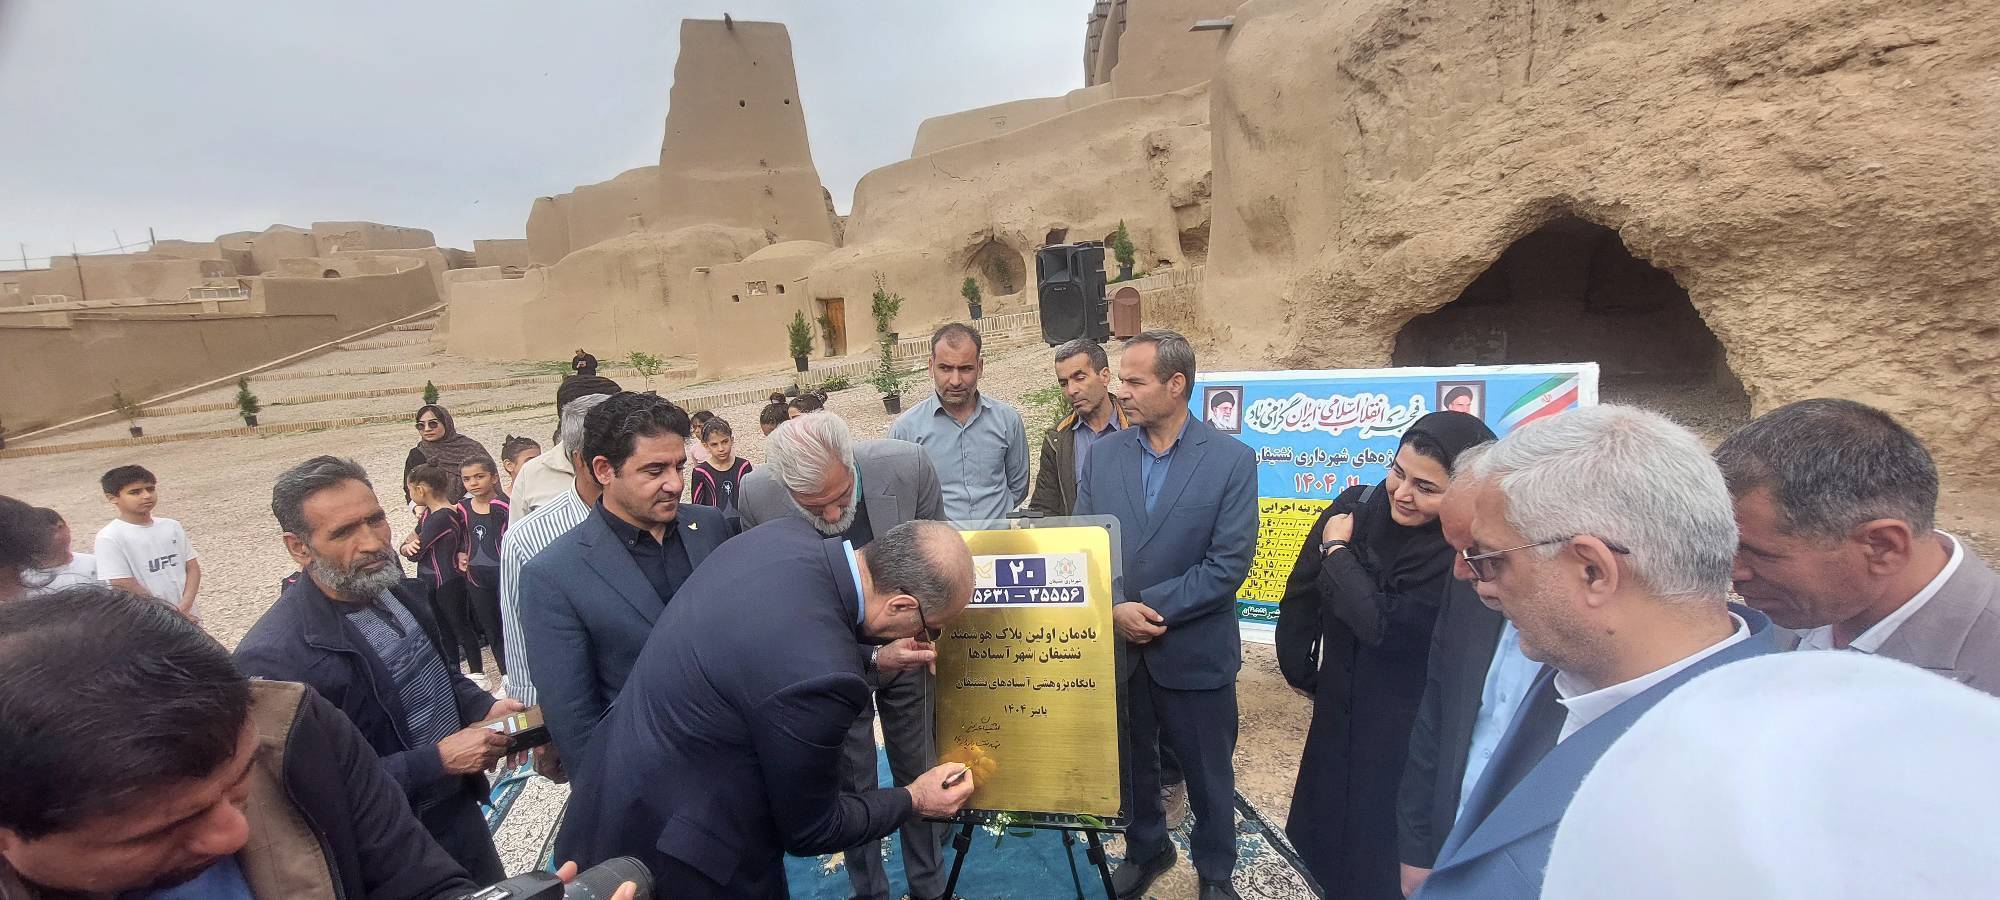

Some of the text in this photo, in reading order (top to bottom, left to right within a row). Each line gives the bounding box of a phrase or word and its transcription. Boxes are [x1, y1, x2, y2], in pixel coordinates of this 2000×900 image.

[1249, 403, 1264, 425] باد
[1259, 396, 1300, 431] گرامی
[1285, 404, 1320, 428] ایران
[1320, 397, 1360, 421] اسلامی
[1295, 448, 1349, 467] شهرداری
[1295, 473, 1336, 493] ۱۴۰۴
[1261, 502, 1296, 514] اجرایی
[1009, 560, 1034, 585] ۲۰
[1248, 579, 1262, 589] ریال
[971, 588, 1009, 603] ۵۶۳۱
[1029, 587, 1080, 602] ۳۵۵۵۶
[1241, 589, 1256, 600] ریال
[950, 627, 1097, 645] یادمان اولین پلاک هوشمند
[1012, 646, 1033, 663] شهر
[1039, 646, 1081, 663] نشتیفان
[1033, 679, 1070, 691] پژوهشی
[1071, 678, 1096, 691] پایگاه
[1004, 704, 1048, 718] پاییز ۱۴۰۴
